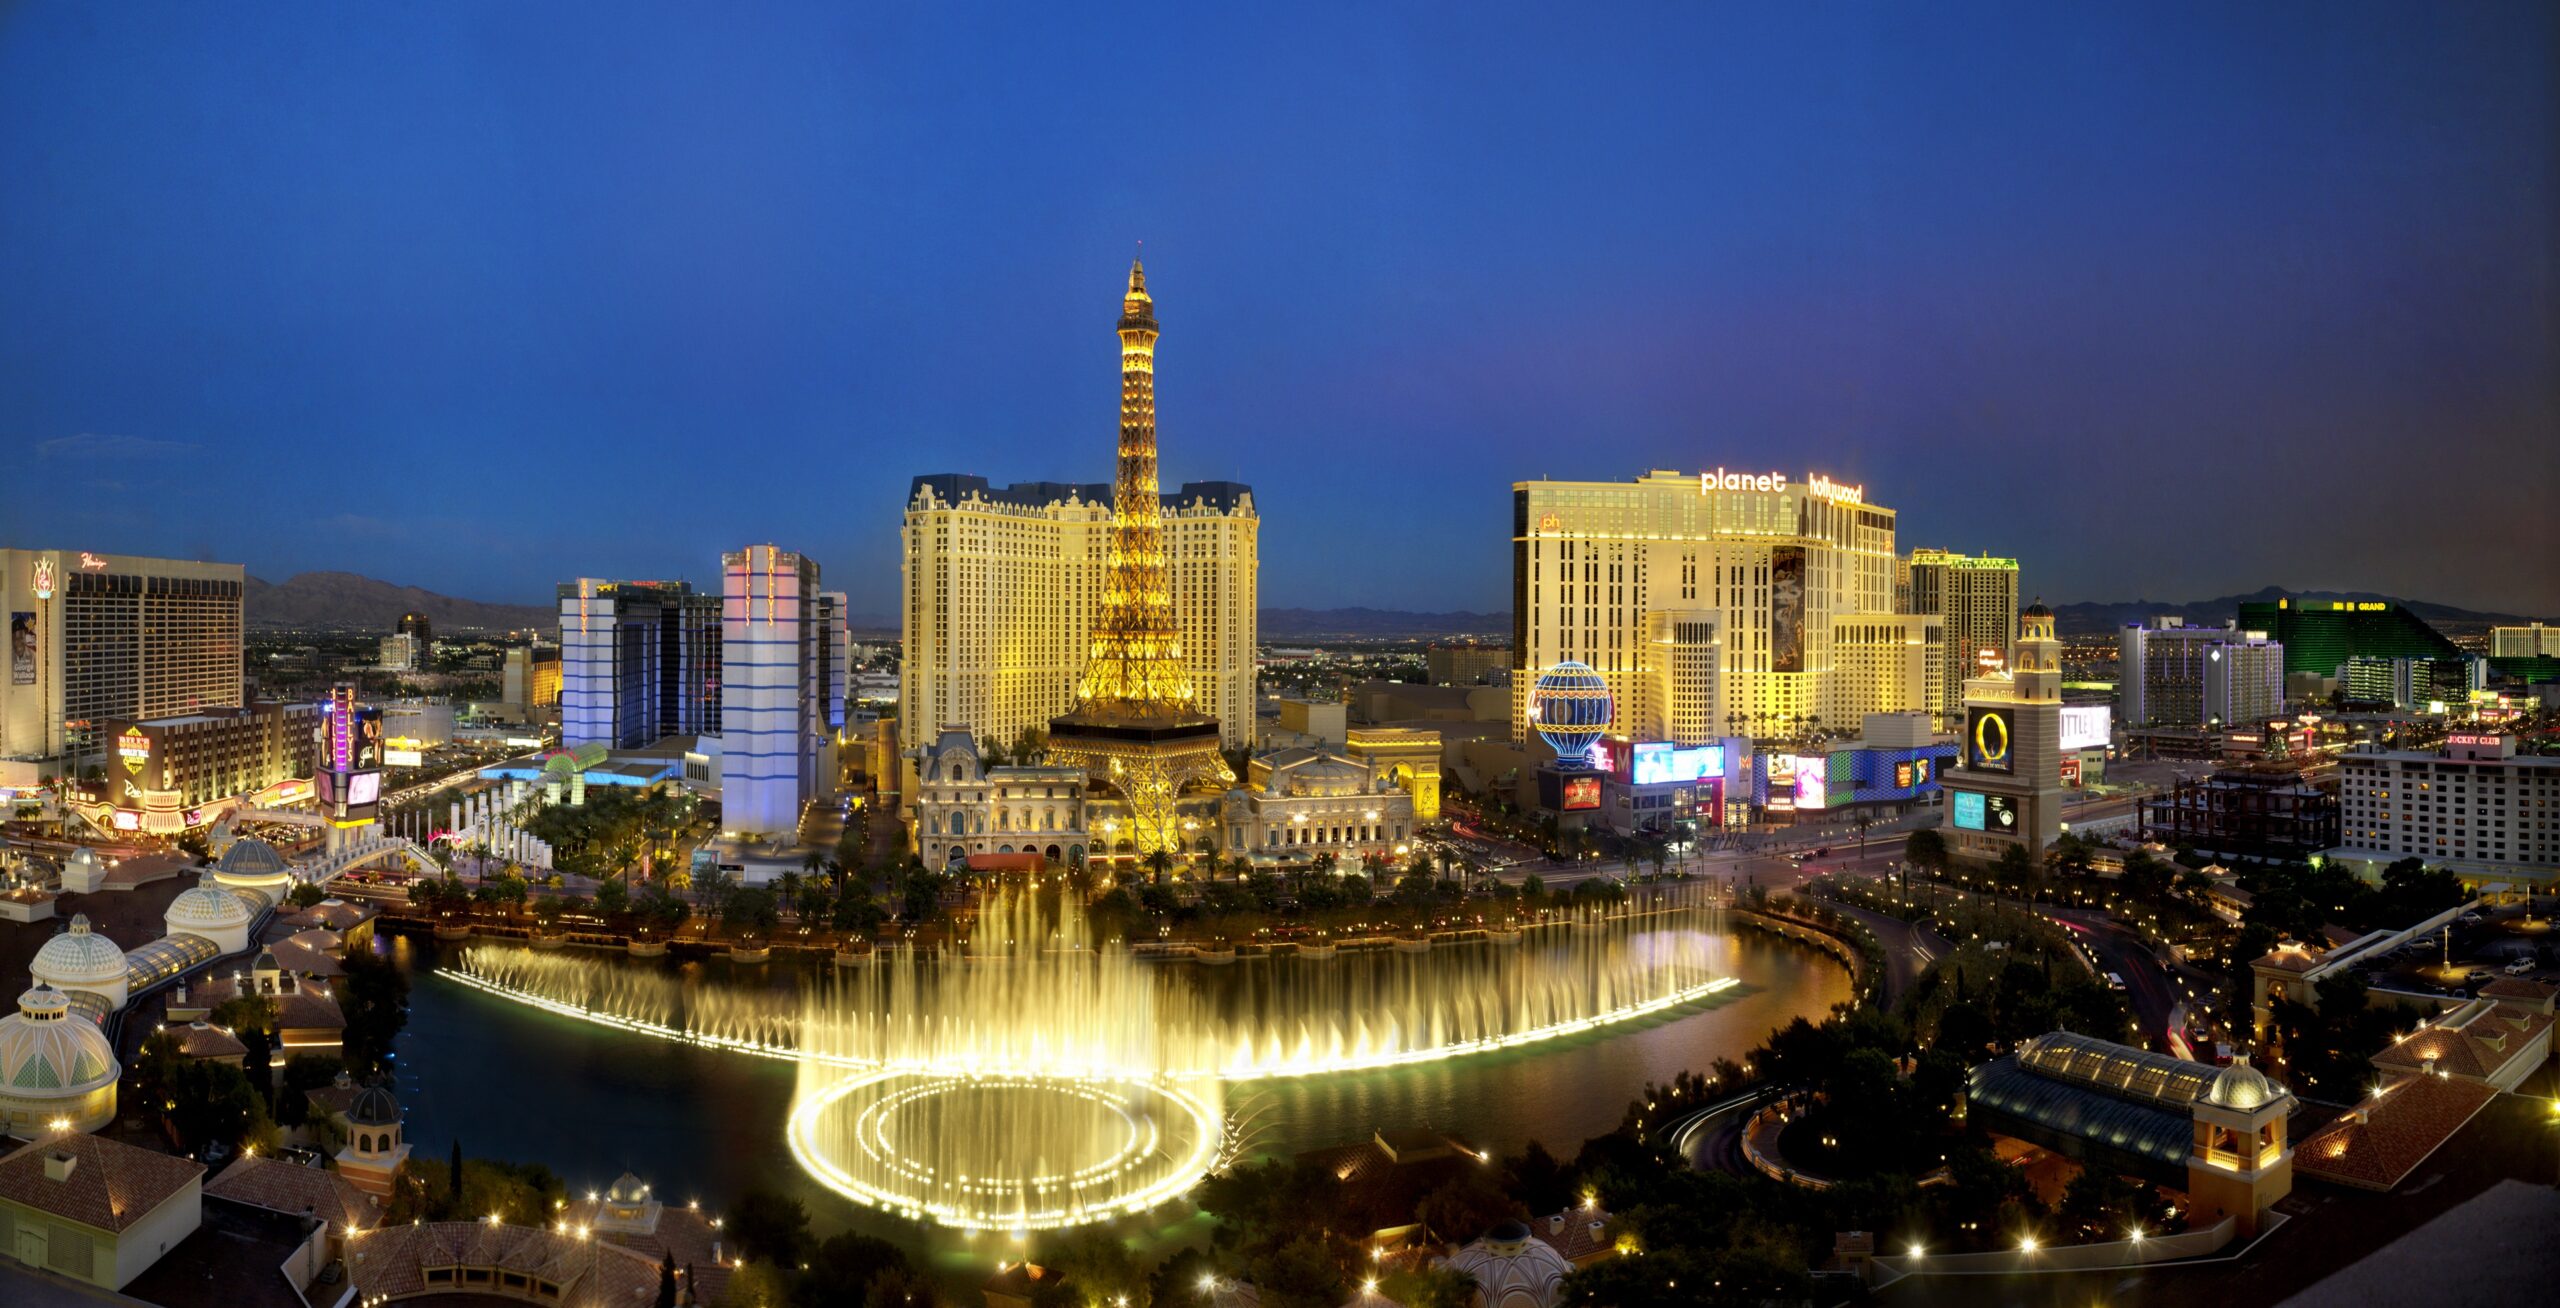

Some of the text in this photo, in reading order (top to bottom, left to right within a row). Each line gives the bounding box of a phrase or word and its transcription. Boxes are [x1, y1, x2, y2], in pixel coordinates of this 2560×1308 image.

[1701, 467, 1786, 496] planet
[1809, 472, 1863, 505] hollywood
[1543, 513, 1560, 530] ph
[2358, 602, 2386, 612] GRAND
[1976, 713, 2008, 760] O
[2447, 735, 2500, 746] JOCKEY CLUB
